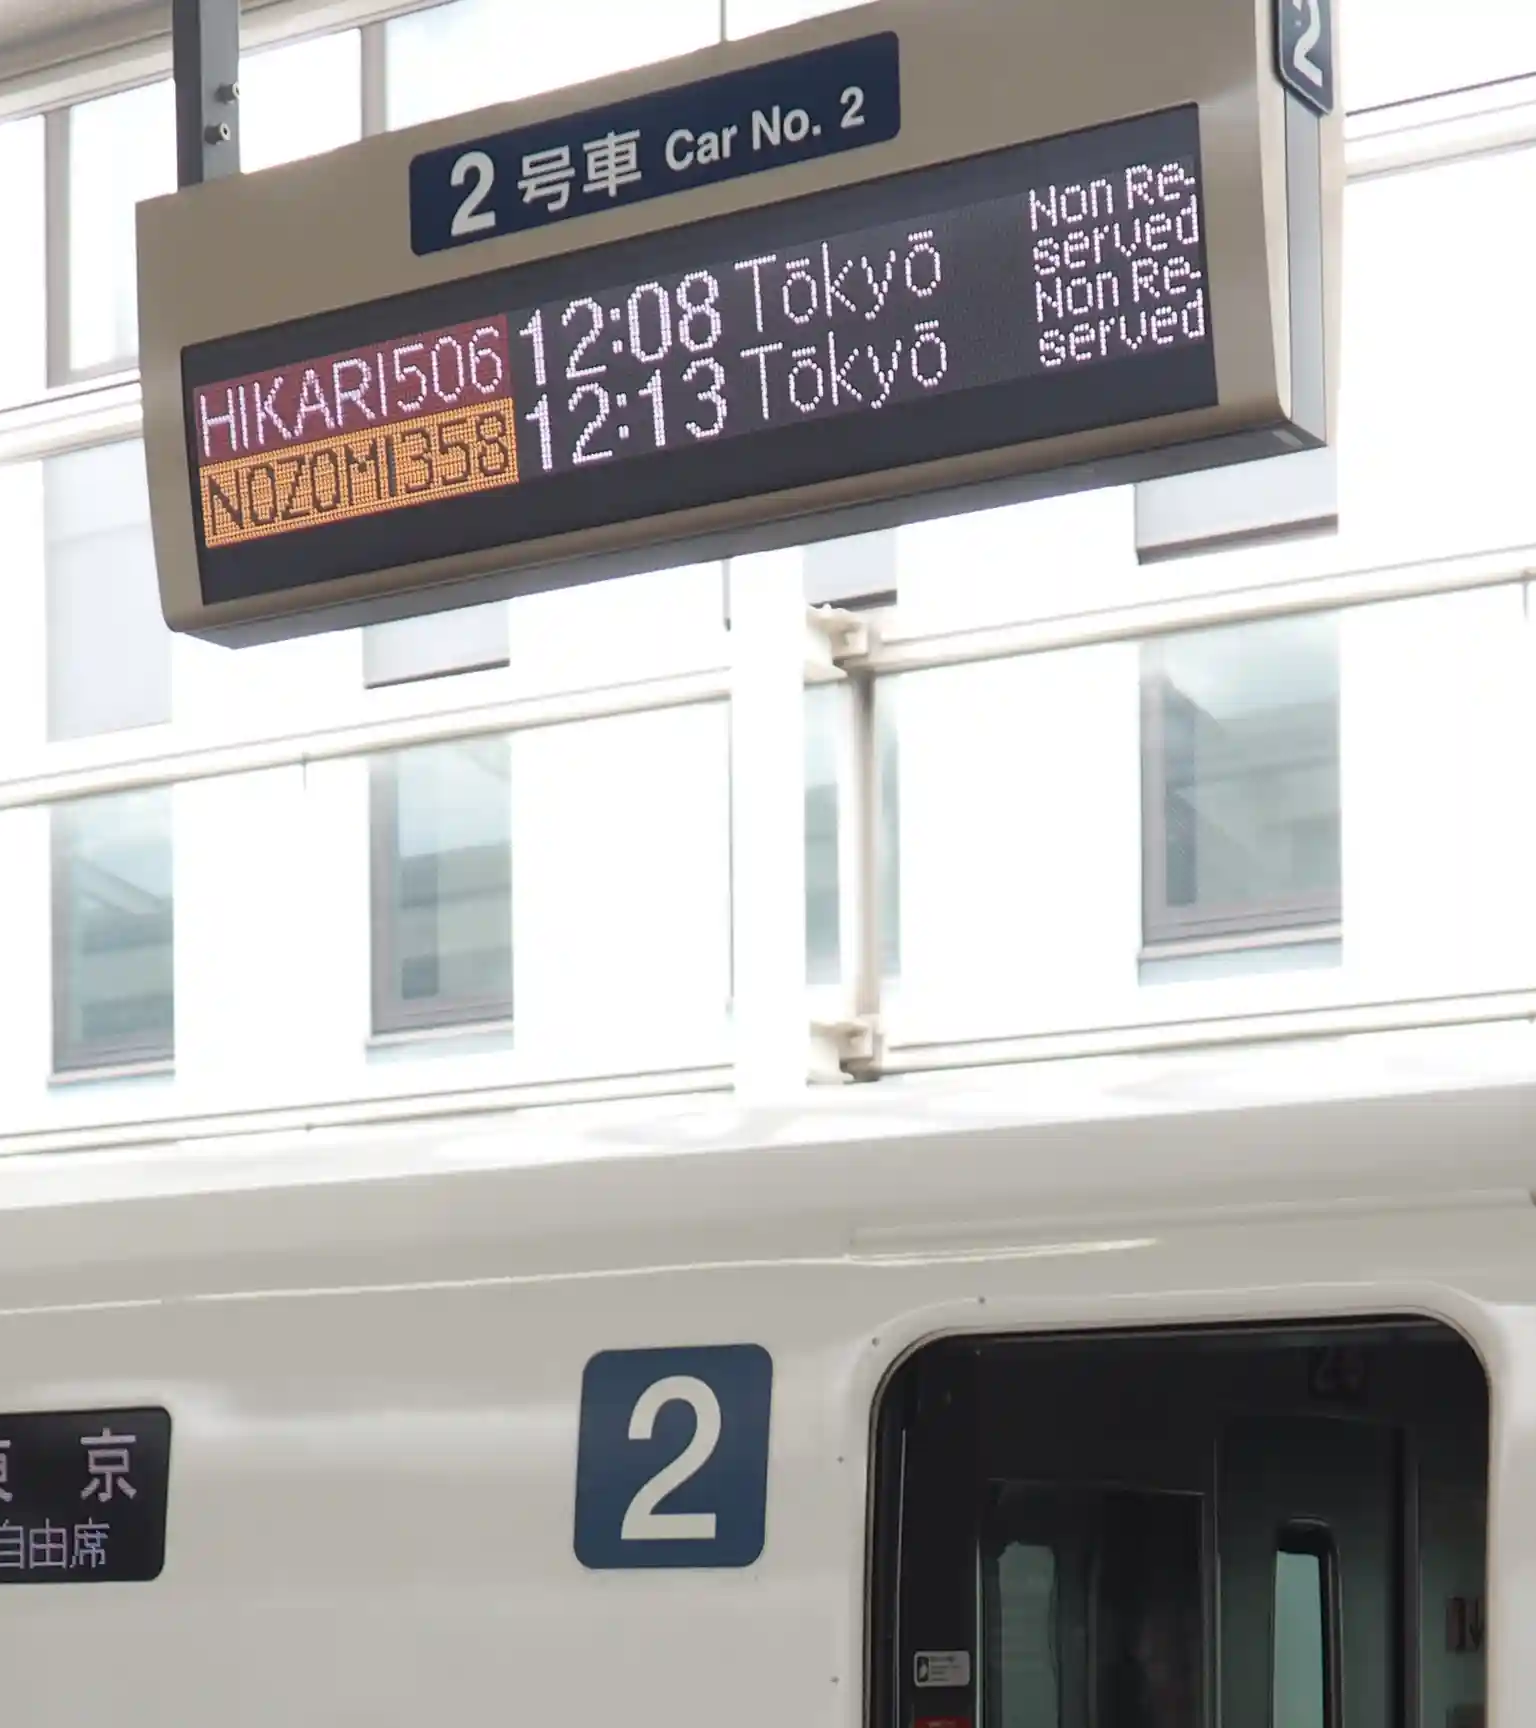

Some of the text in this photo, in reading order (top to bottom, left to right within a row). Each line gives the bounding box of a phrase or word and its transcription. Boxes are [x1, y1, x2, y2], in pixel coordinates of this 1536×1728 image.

[665, 124, 738, 172] Car
[751, 105, 821, 150] No.
[839, 86, 865, 129] 2
[1029, 178, 1114, 231] Non
[1033, 194, 1199, 275] served
[519, 269, 722, 386] 12:08
[734, 229, 942, 333] Tōkyō
[1035, 271, 1119, 322] Non
[1039, 288, 1206, 367] served
[525, 357, 728, 472] 12:13
[739, 319, 948, 420] Tōkyō
[619, 1375, 723, 1540] 2
